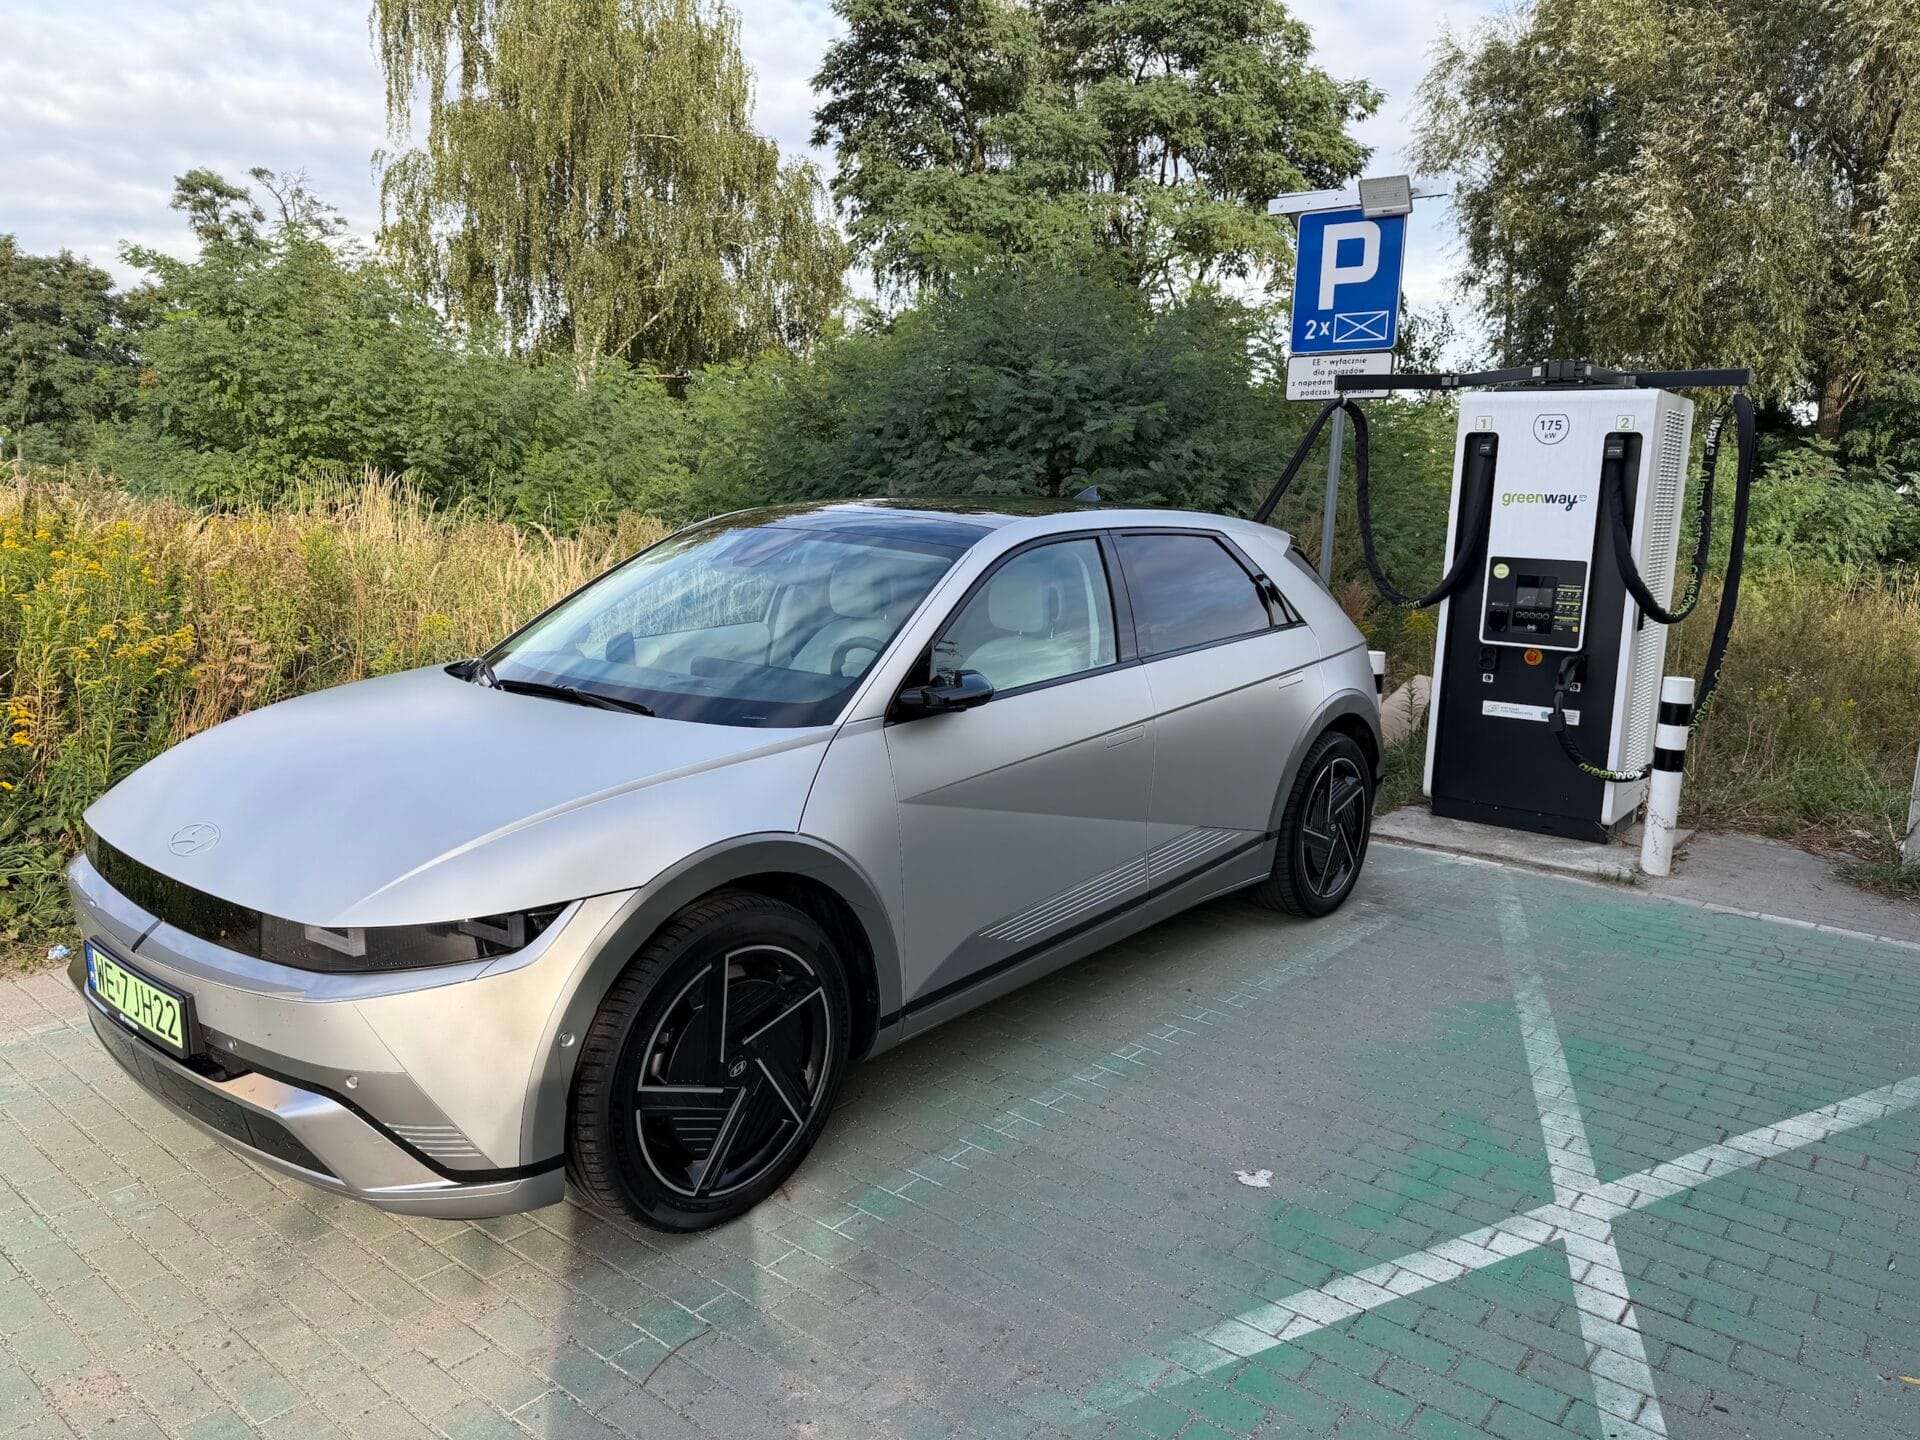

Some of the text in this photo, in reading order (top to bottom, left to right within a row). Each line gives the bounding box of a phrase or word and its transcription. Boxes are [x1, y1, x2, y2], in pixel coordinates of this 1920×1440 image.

[1318, 220, 1381, 311] P
[1312, 358, 1321, 366] EE
[1300, 389, 1331, 398] podczas
[1480, 419, 1487, 429] 1
[1540, 419, 1562, 431] 175
[1620, 418, 1630, 428] 2
[1502, 492, 1578, 511] greenway
[95, 954, 116, 1002] WE
